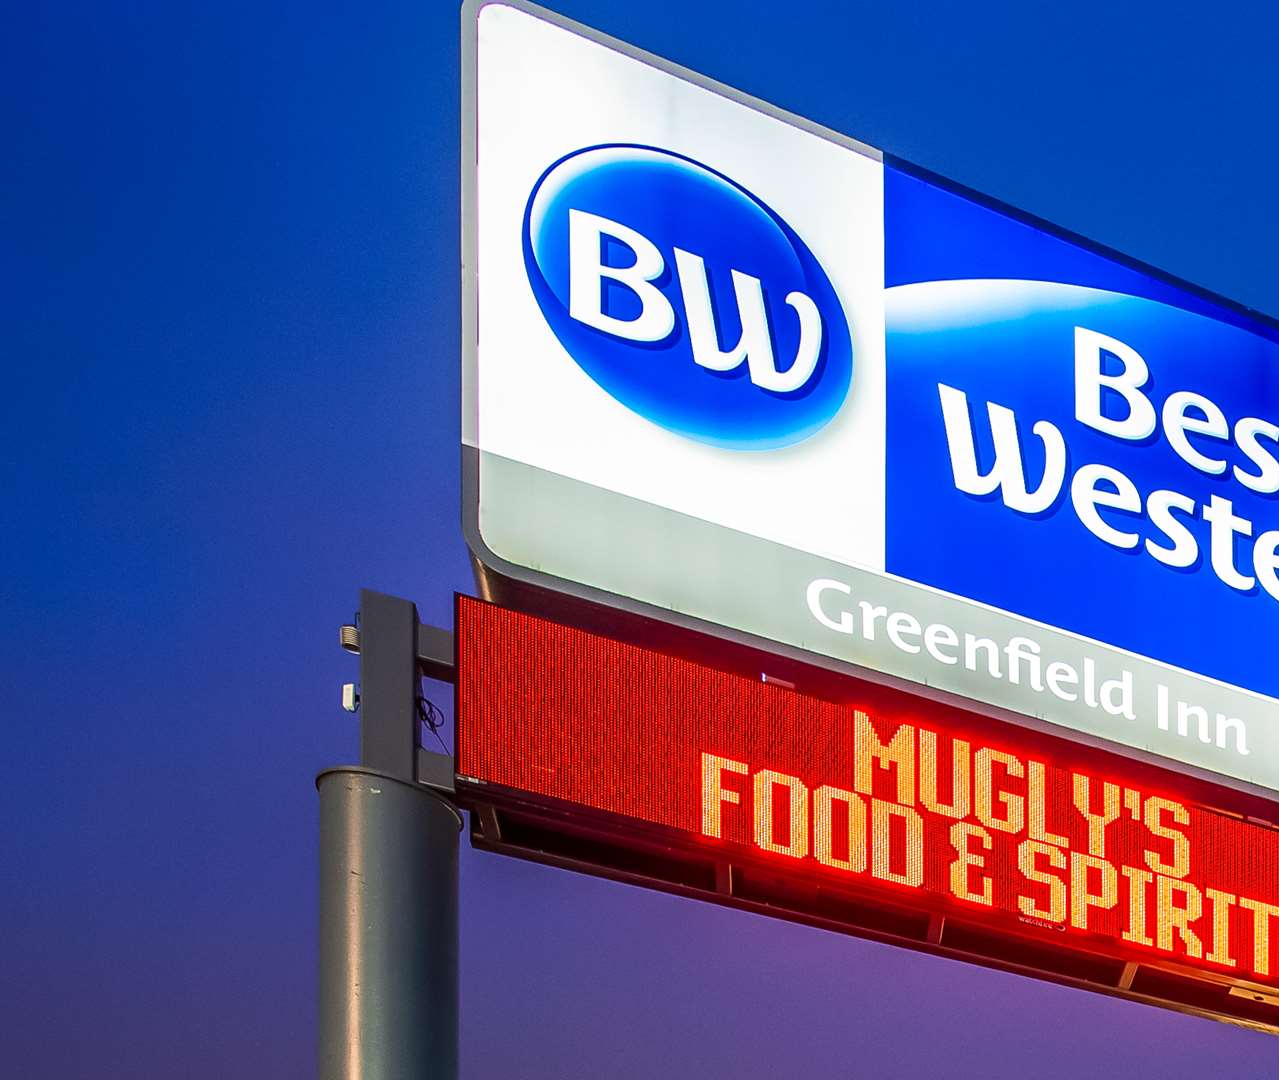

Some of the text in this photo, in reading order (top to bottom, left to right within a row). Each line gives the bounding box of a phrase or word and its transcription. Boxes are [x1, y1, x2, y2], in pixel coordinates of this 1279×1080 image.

[568, 207, 823, 394] BW
[806, 577, 1250, 755] Greenfield Inn
[701, 751, 924, 888] FOOD
[949, 821, 993, 906] &
[853, 709, 1190, 879] MUGLY'S
